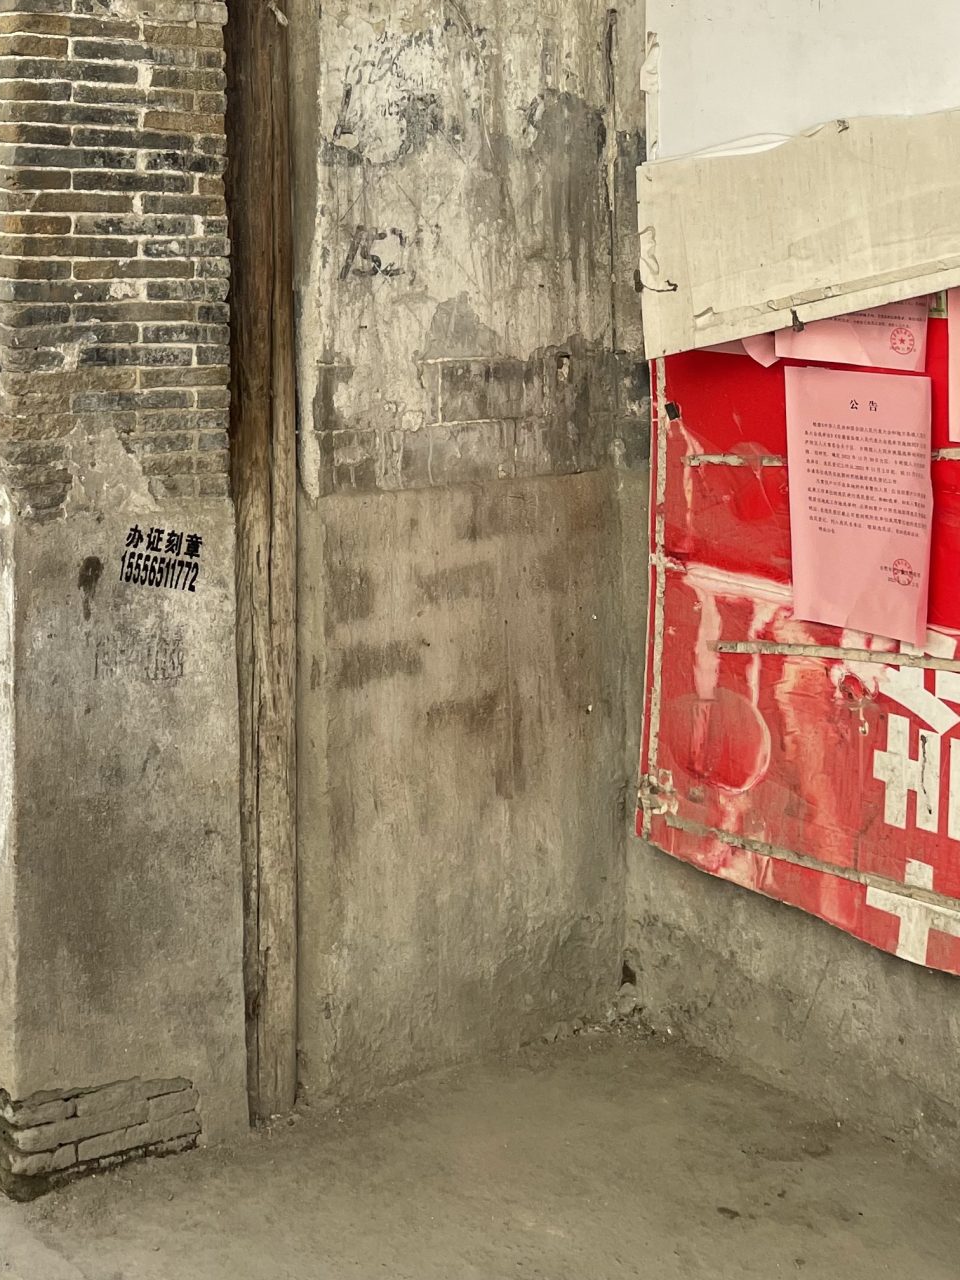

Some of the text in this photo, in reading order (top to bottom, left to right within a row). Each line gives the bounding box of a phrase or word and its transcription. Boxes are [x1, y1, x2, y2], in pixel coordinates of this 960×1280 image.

[849, 399, 878, 412] 公告
[125, 524, 203, 559] 办证刻章
[119, 550, 199, 592] 15556511772
